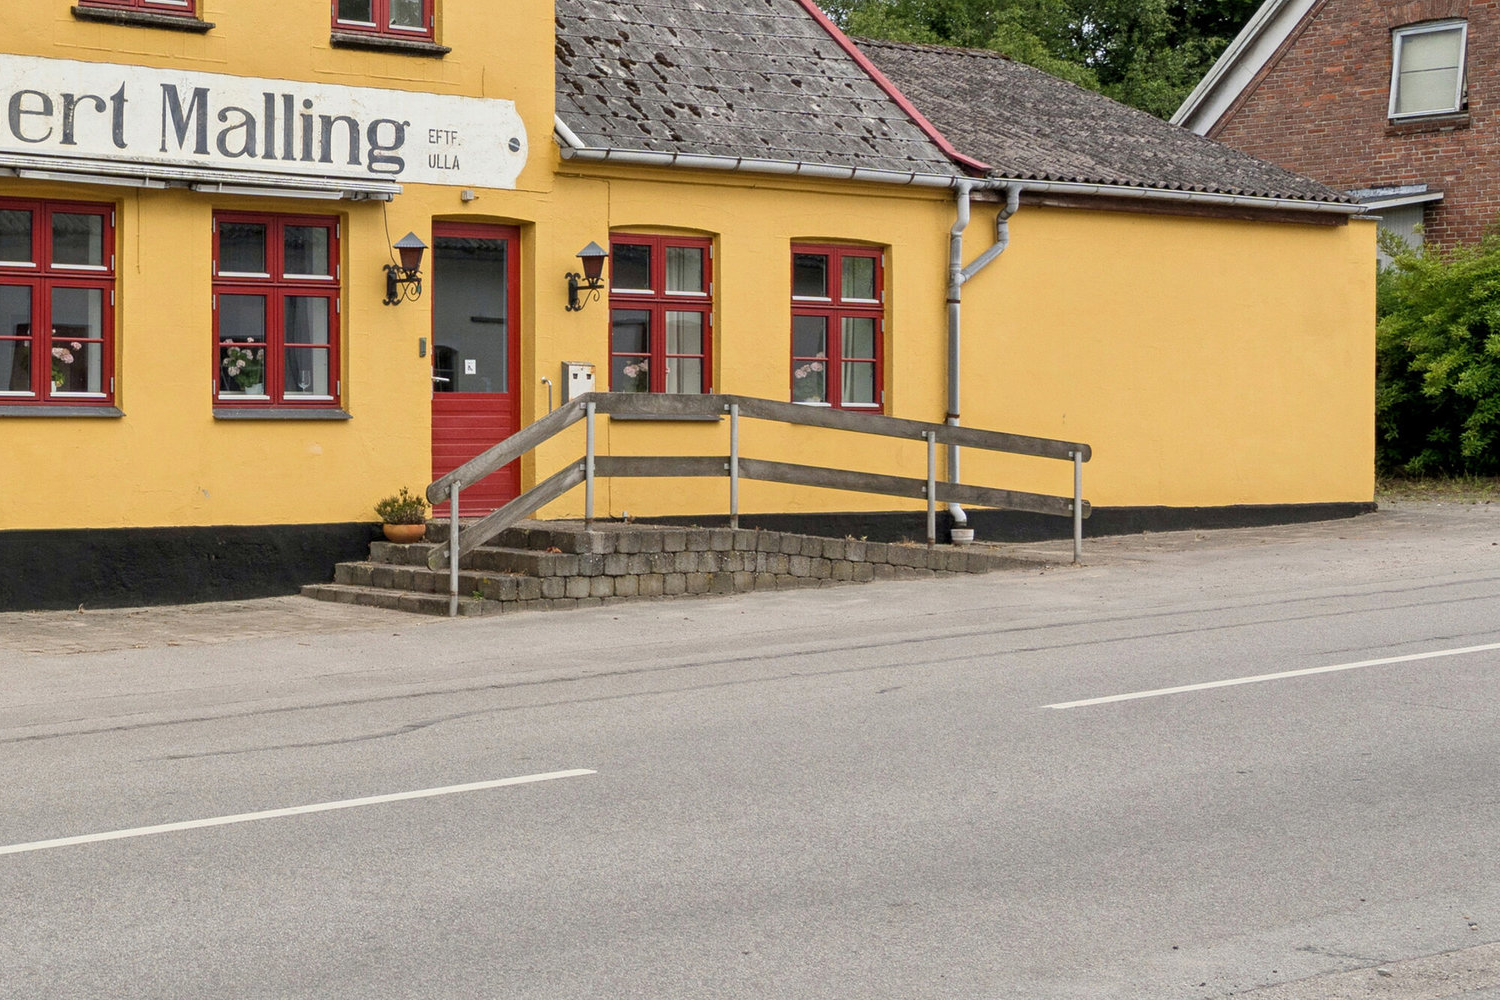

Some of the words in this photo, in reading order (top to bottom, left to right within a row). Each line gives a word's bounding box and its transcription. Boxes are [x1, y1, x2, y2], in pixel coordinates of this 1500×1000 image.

[159, 83, 411, 175] Malling
[428, 128, 461, 146] EFTF.
[428, 153, 460, 170] ULLA
